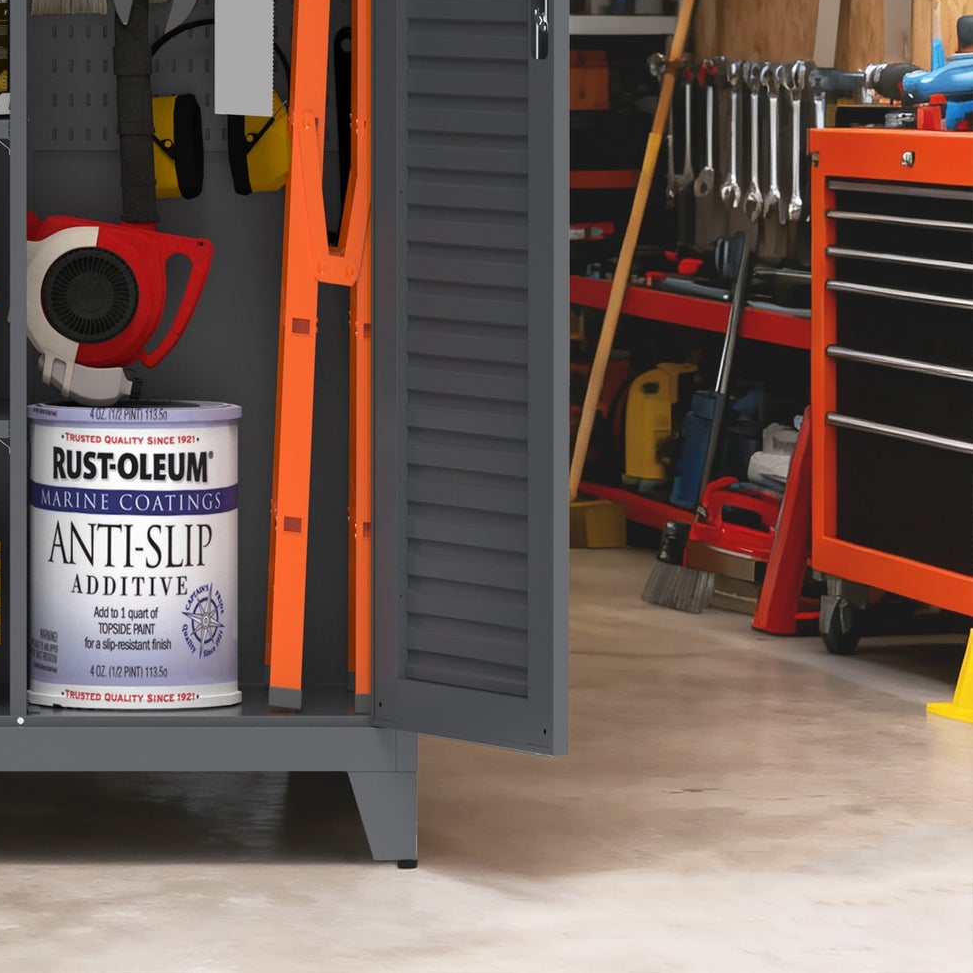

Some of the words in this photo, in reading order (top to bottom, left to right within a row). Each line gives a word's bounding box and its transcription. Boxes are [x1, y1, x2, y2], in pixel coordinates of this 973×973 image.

[64, 432, 101, 444] TRUSTED
[104, 434, 143, 445] QUALITY
[147, 436, 175, 445] SINCE
[177, 435, 195, 444] 1921
[41, 488, 109, 510] MARINE
[119, 492, 221, 512] COATINGS
[48, 520, 212, 569] ANTI-SLIP
[71, 573, 188, 597] ADDITIVE
[94, 606, 109, 618] Add
[111, 607, 118, 618] to
[121, 607, 126, 618] 1
[128, 608, 149, 621] quart
[150, 607, 159, 619] of
[98, 622, 131, 635] TOPSIDE
[133, 623, 155, 635] PAINT
[84, 637, 94, 649] for
[95, 640, 101, 650] a
[102, 638, 150, 652] slip-resistant
[152, 638, 172, 650] finish
[90, 665, 95, 677] 4
[64, 689, 101, 701] TRUSTED
[104, 692, 144, 702] QUALITY
[147, 694, 174, 703] SINCE
[177, 692, 195, 702] 1921
